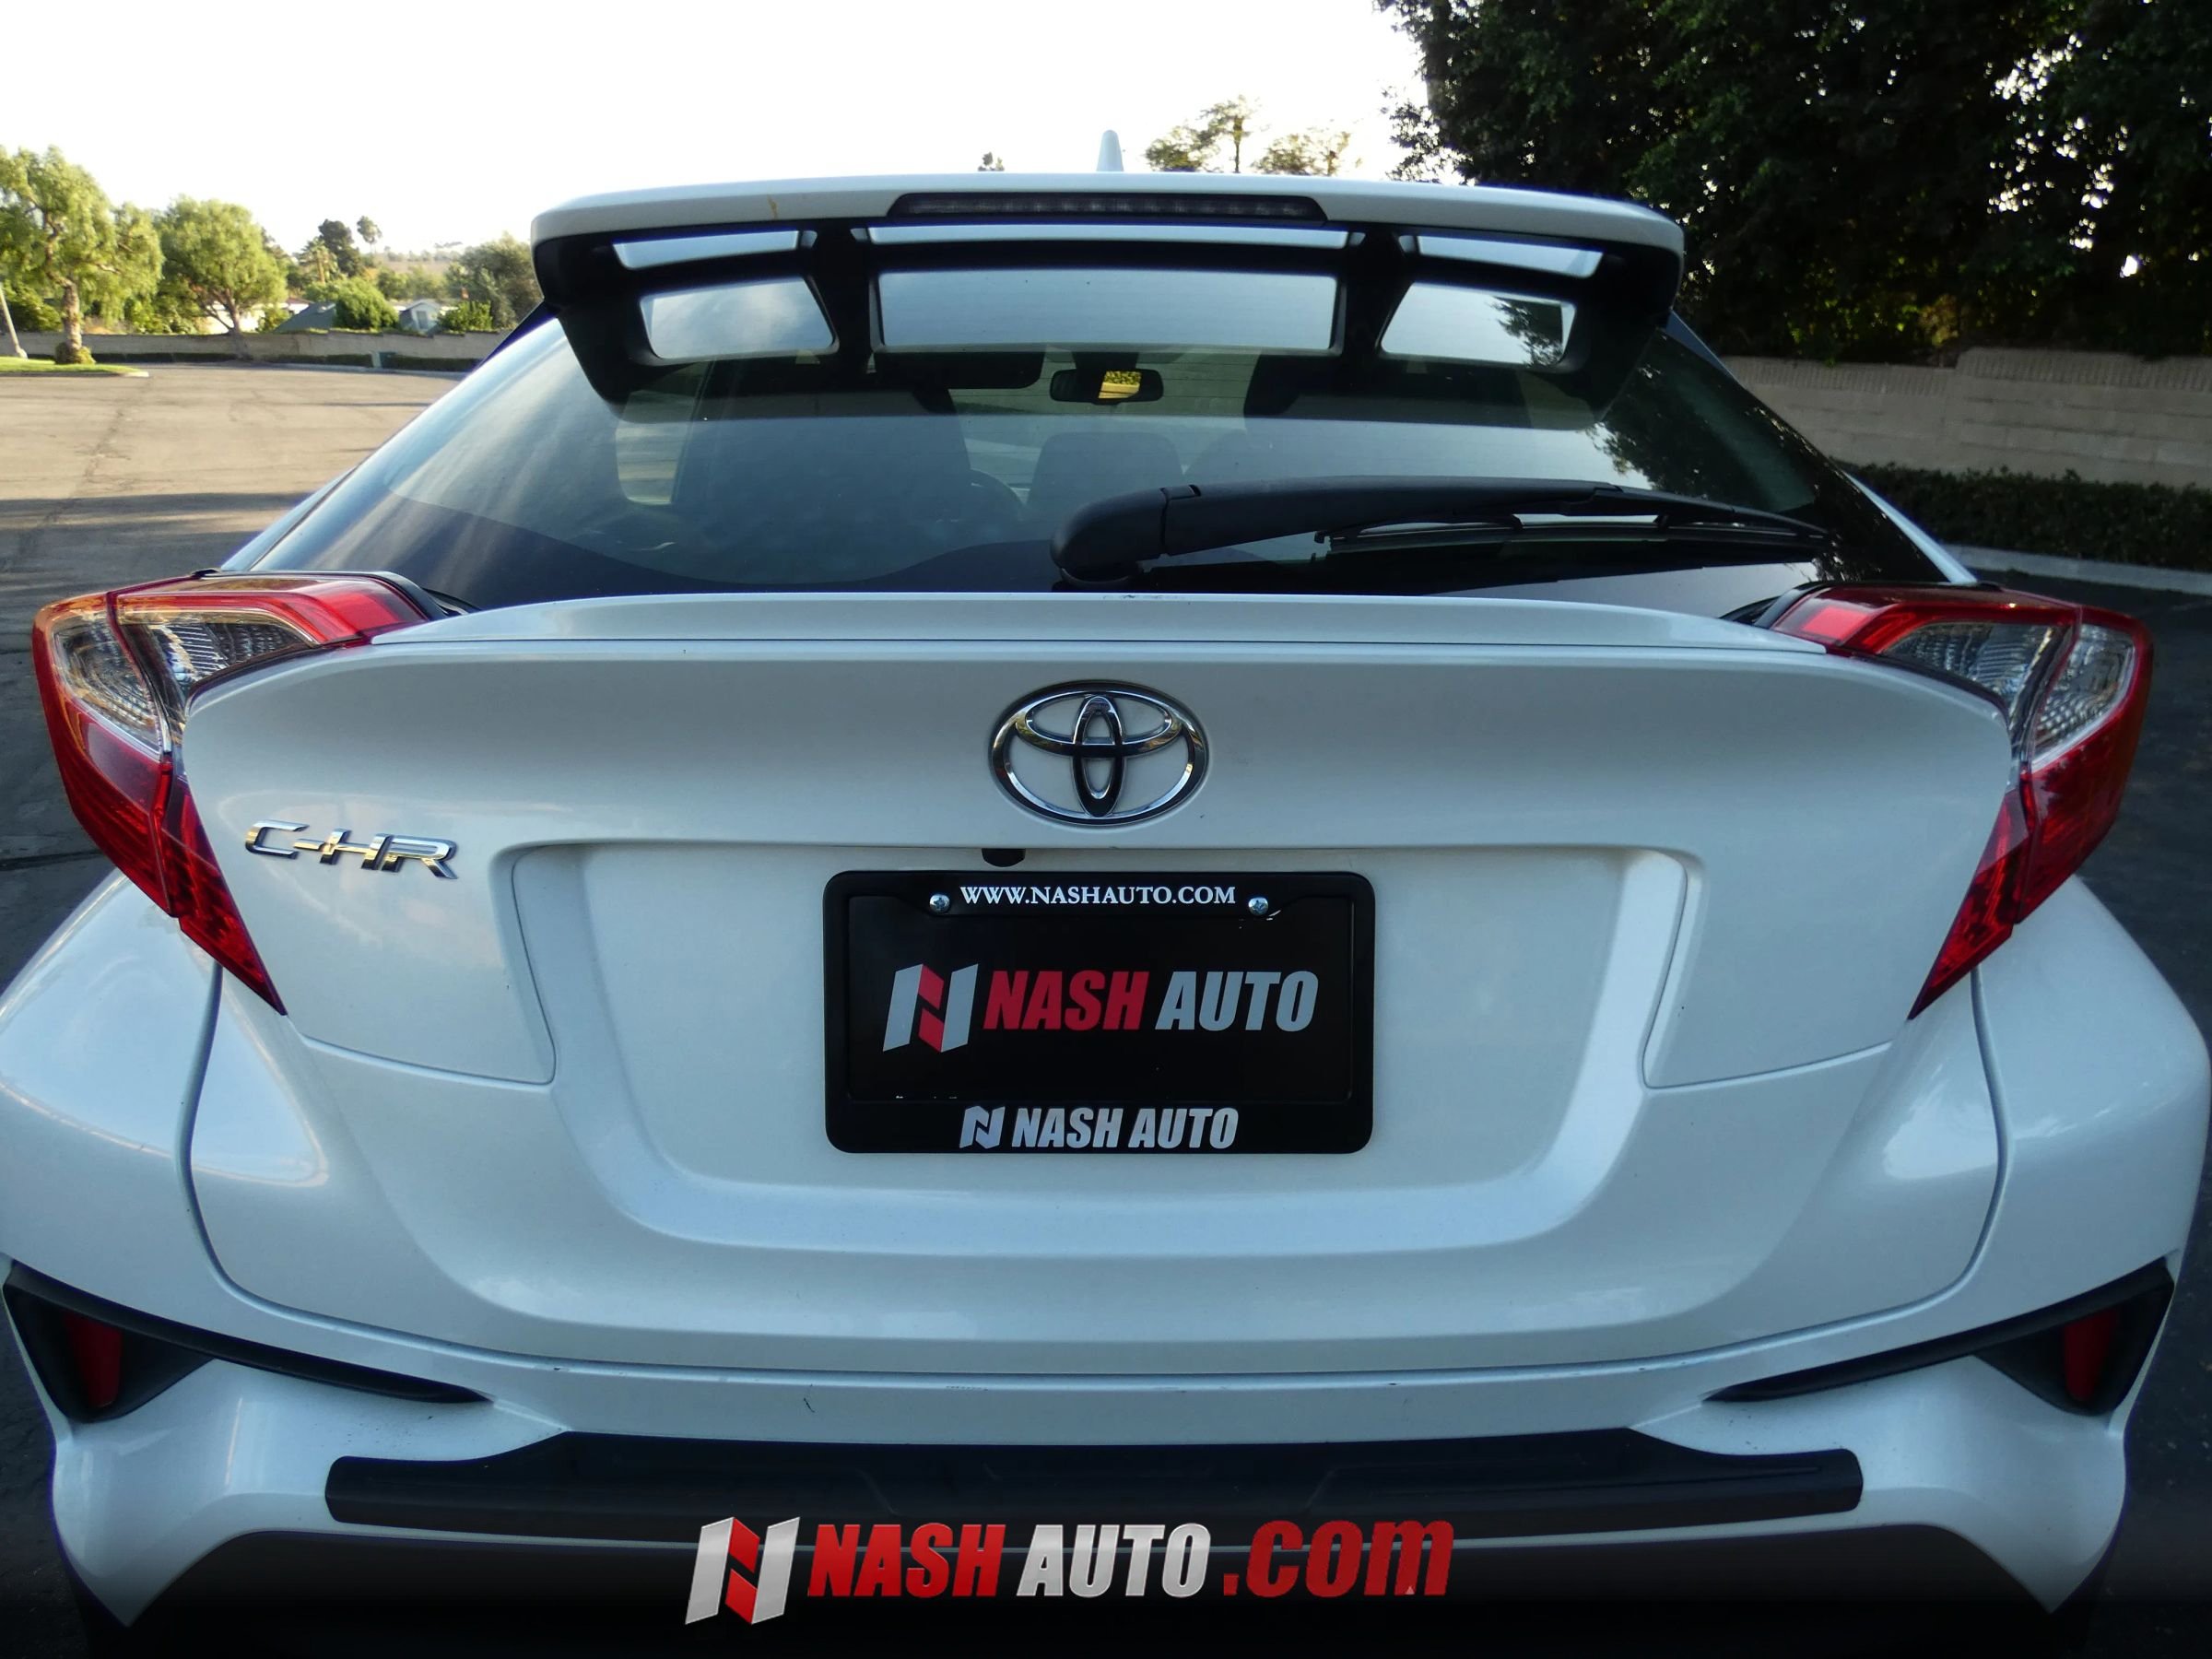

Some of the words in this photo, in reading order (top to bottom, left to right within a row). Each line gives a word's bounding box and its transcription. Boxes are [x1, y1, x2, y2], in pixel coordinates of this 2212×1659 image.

[245, 819, 459, 880] C-HR
[959, 886, 1236, 906] WWW.NASHAUTO.COM
[982, 971, 1150, 1030] NASH
[1155, 971, 1320, 1032] AUTO
[1012, 1107, 1124, 1149] NASH
[1128, 1107, 1240, 1150] AUTO
